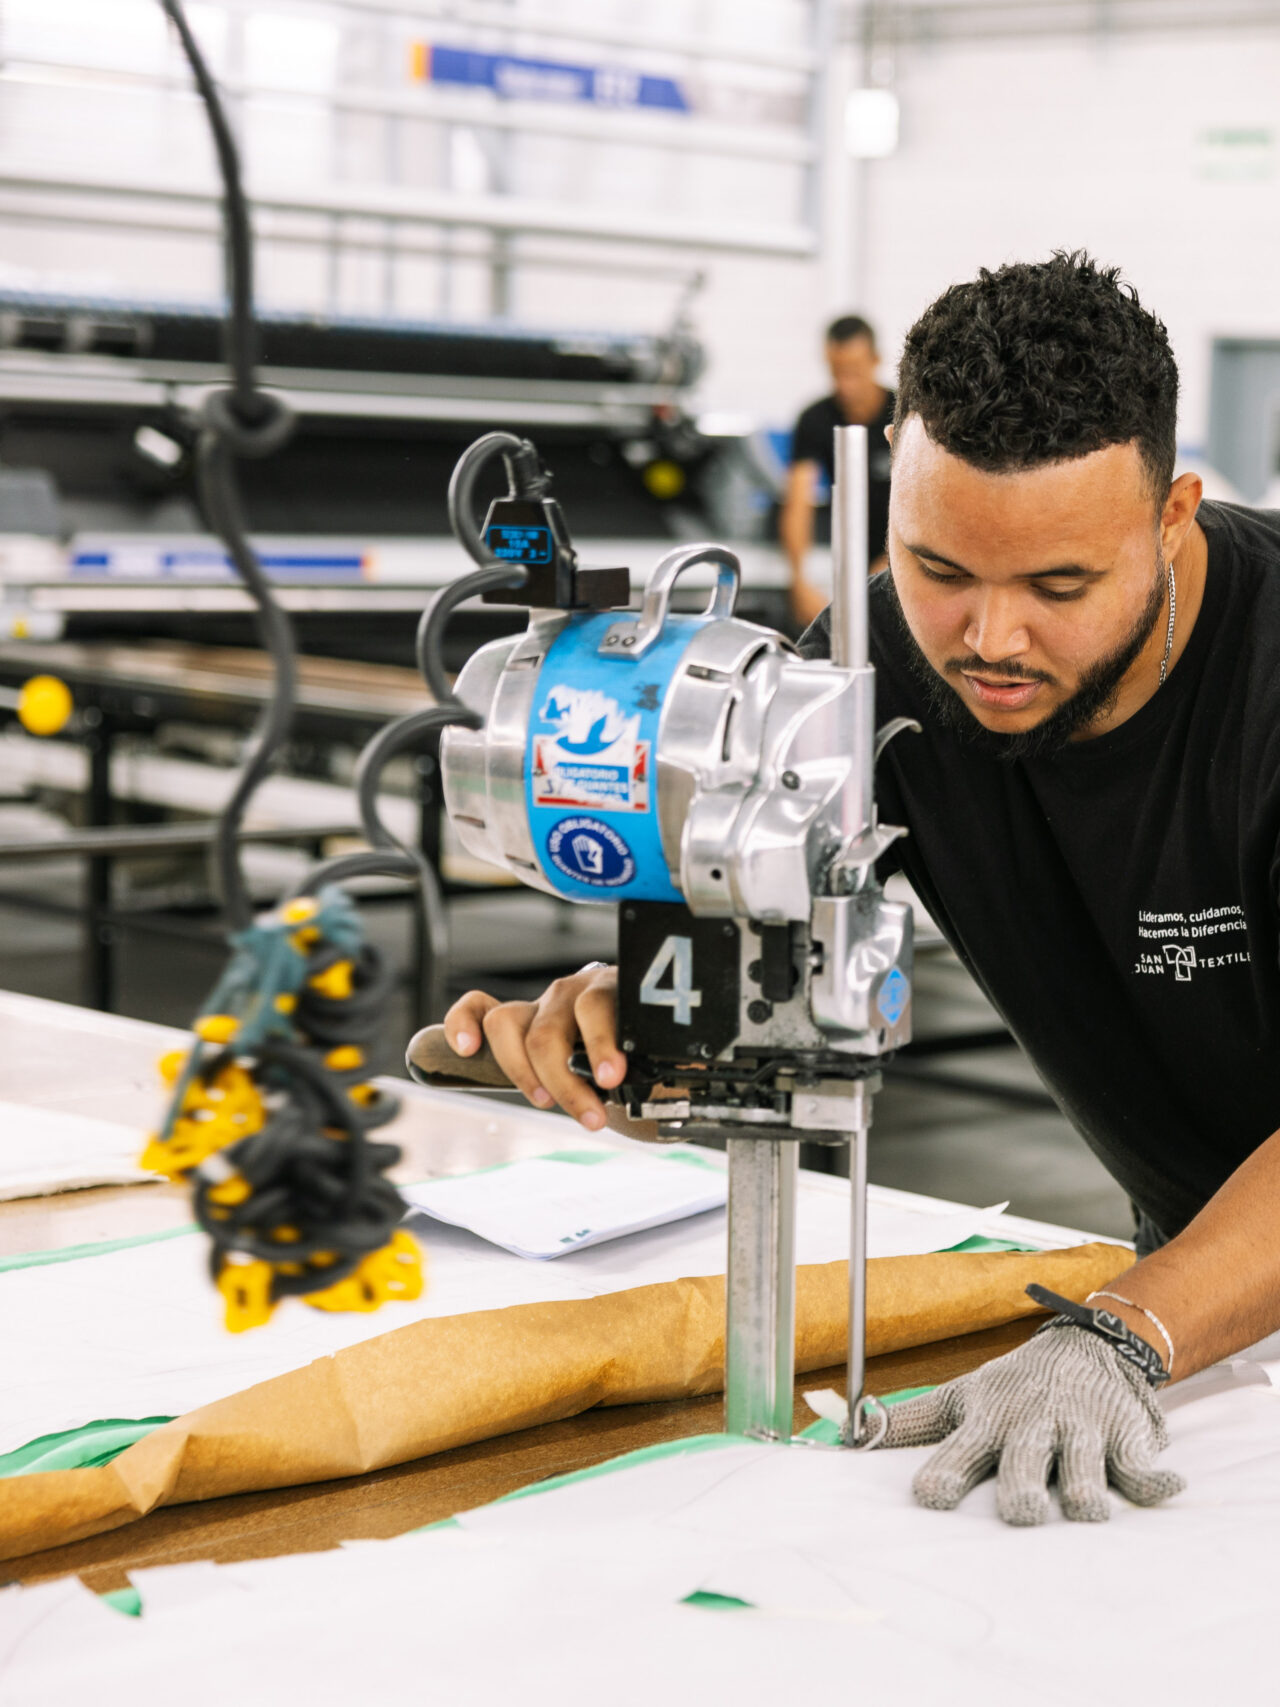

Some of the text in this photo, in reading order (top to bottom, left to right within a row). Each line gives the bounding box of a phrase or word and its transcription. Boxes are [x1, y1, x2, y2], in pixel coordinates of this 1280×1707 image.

[557, 765, 620, 782] LIGATORIO
[1189, 905, 1245, 922] cuidamos,
[1138, 918, 1247, 939] Hacemos la Diferencia
[1140, 953, 1162, 964] SAN
[1134, 964, 1164, 974] JUAN
[639, 934, 702, 1026] 4
